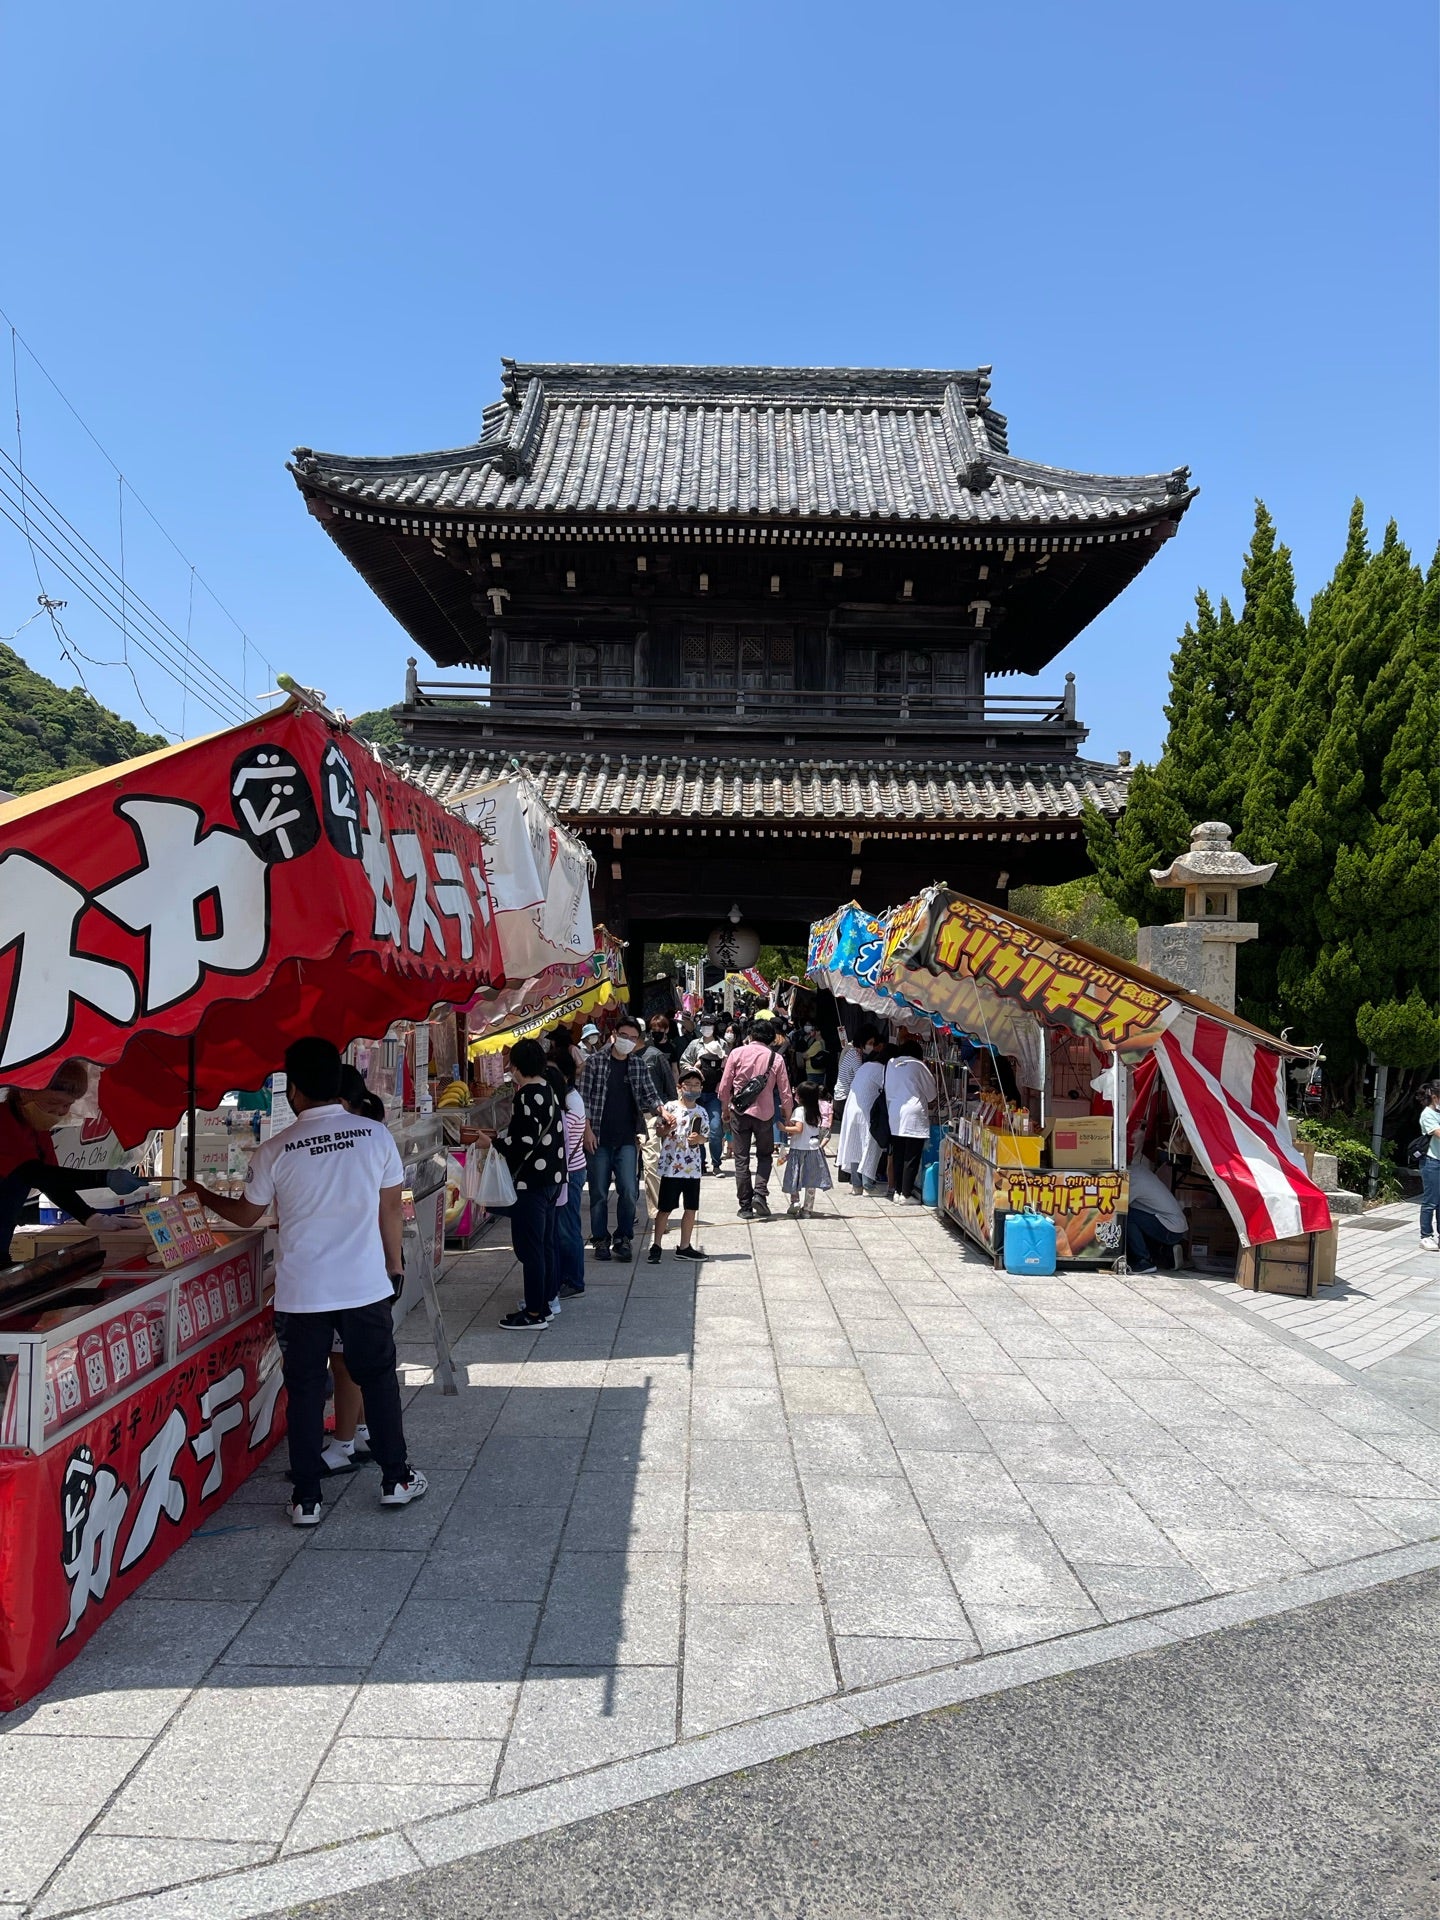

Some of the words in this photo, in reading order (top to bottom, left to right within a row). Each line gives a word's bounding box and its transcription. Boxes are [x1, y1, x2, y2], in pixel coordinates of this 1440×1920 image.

[937, 916, 1161, 1043] カリカリチーズ
[512, 1018, 544, 1038] FRIED
[544, 999, 583, 1024] POTATO
[285, 1134, 332, 1152] MASTER
[334, 1128, 372, 1141] BUNNY
[310, 1140, 355, 1156] EDITION
[1009, 1185, 1122, 1215] カリカリチーズ
